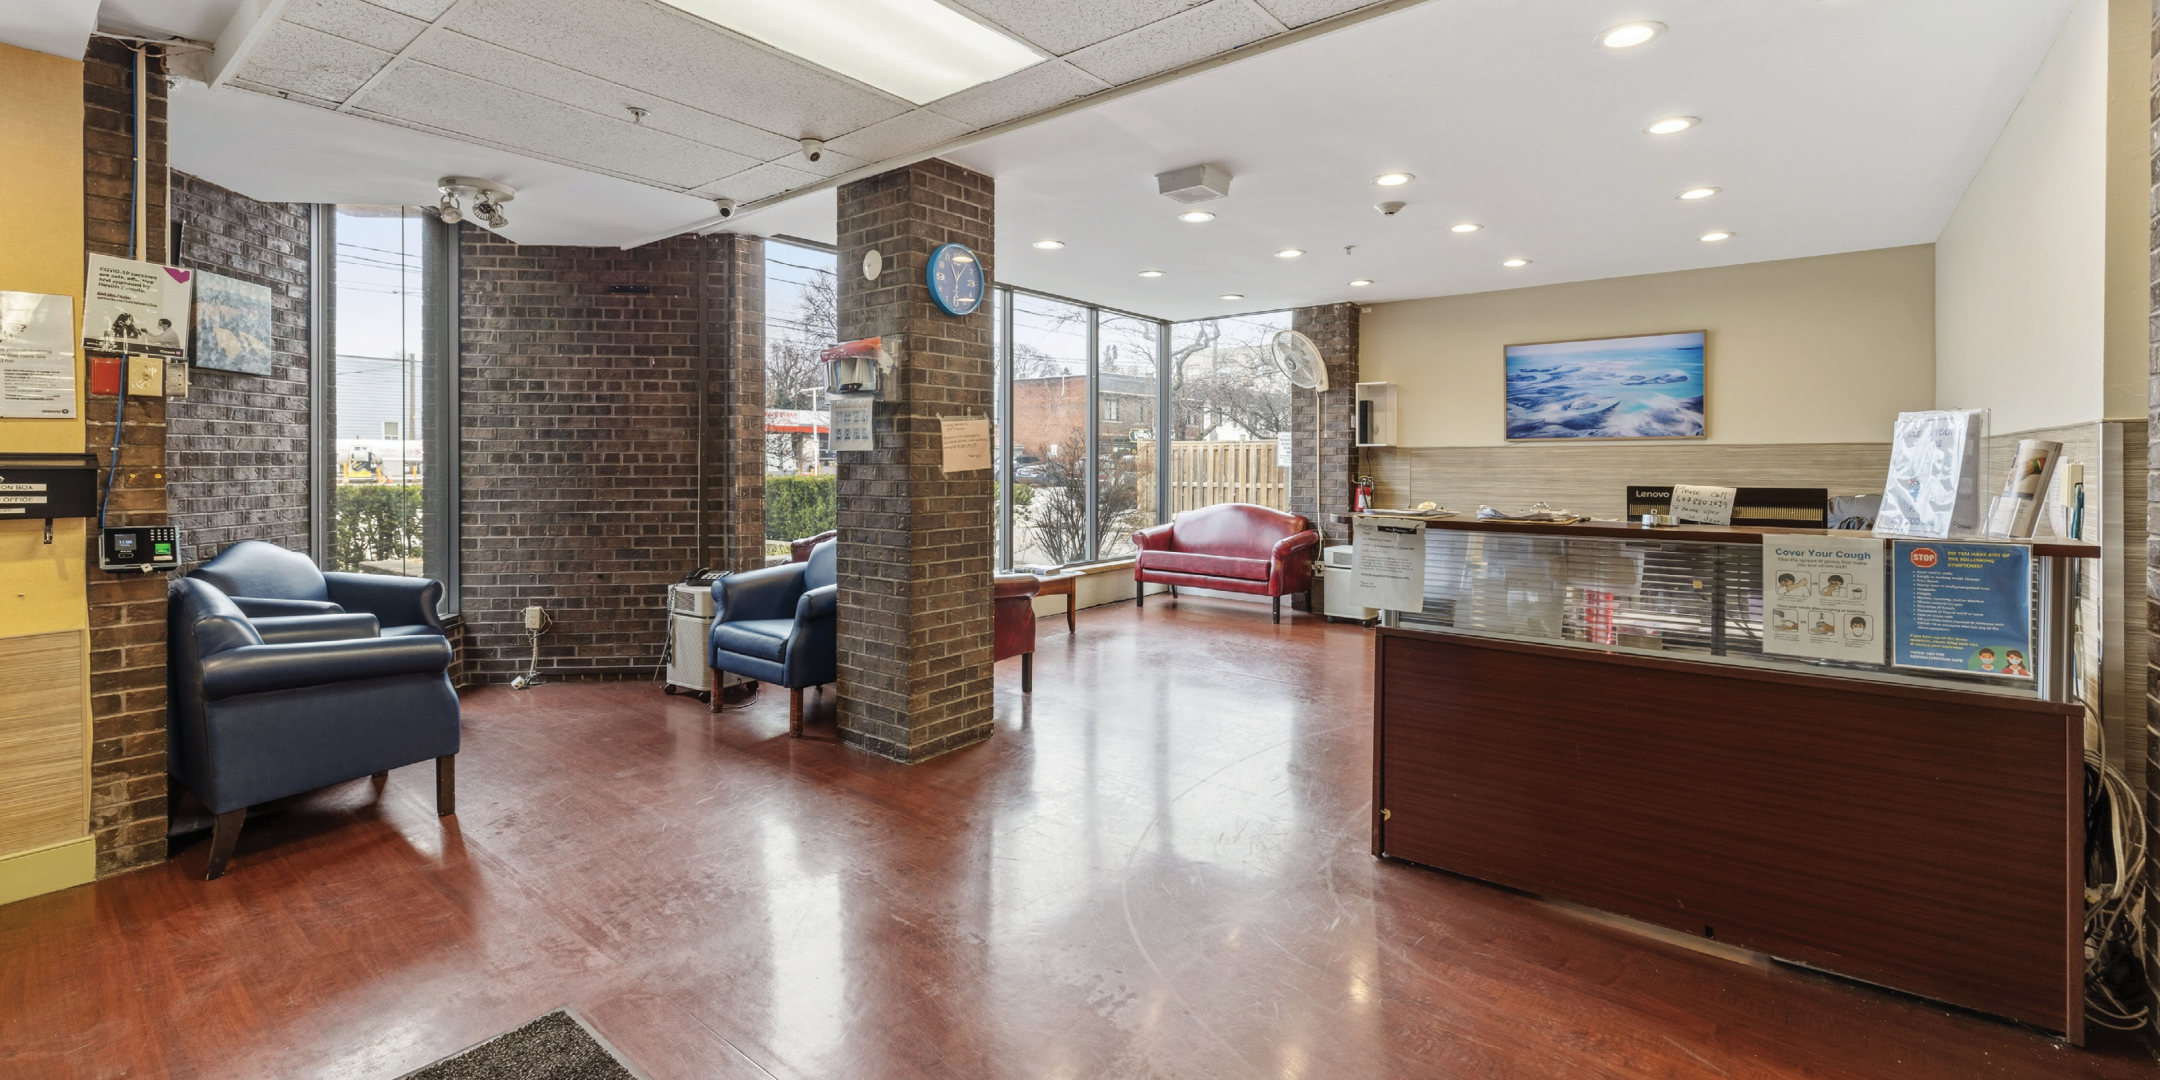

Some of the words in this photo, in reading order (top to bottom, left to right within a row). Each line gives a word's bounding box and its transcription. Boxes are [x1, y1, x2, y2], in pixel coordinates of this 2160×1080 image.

[1636, 490, 1670, 498] Lenovo
[1675, 486, 1701, 496] Please
[1775, 548, 1805, 557] Cover
[1808, 549, 1833, 558] Your
[1836, 550, 1872, 560] Cough
[1913, 553, 1935, 562] STOP
